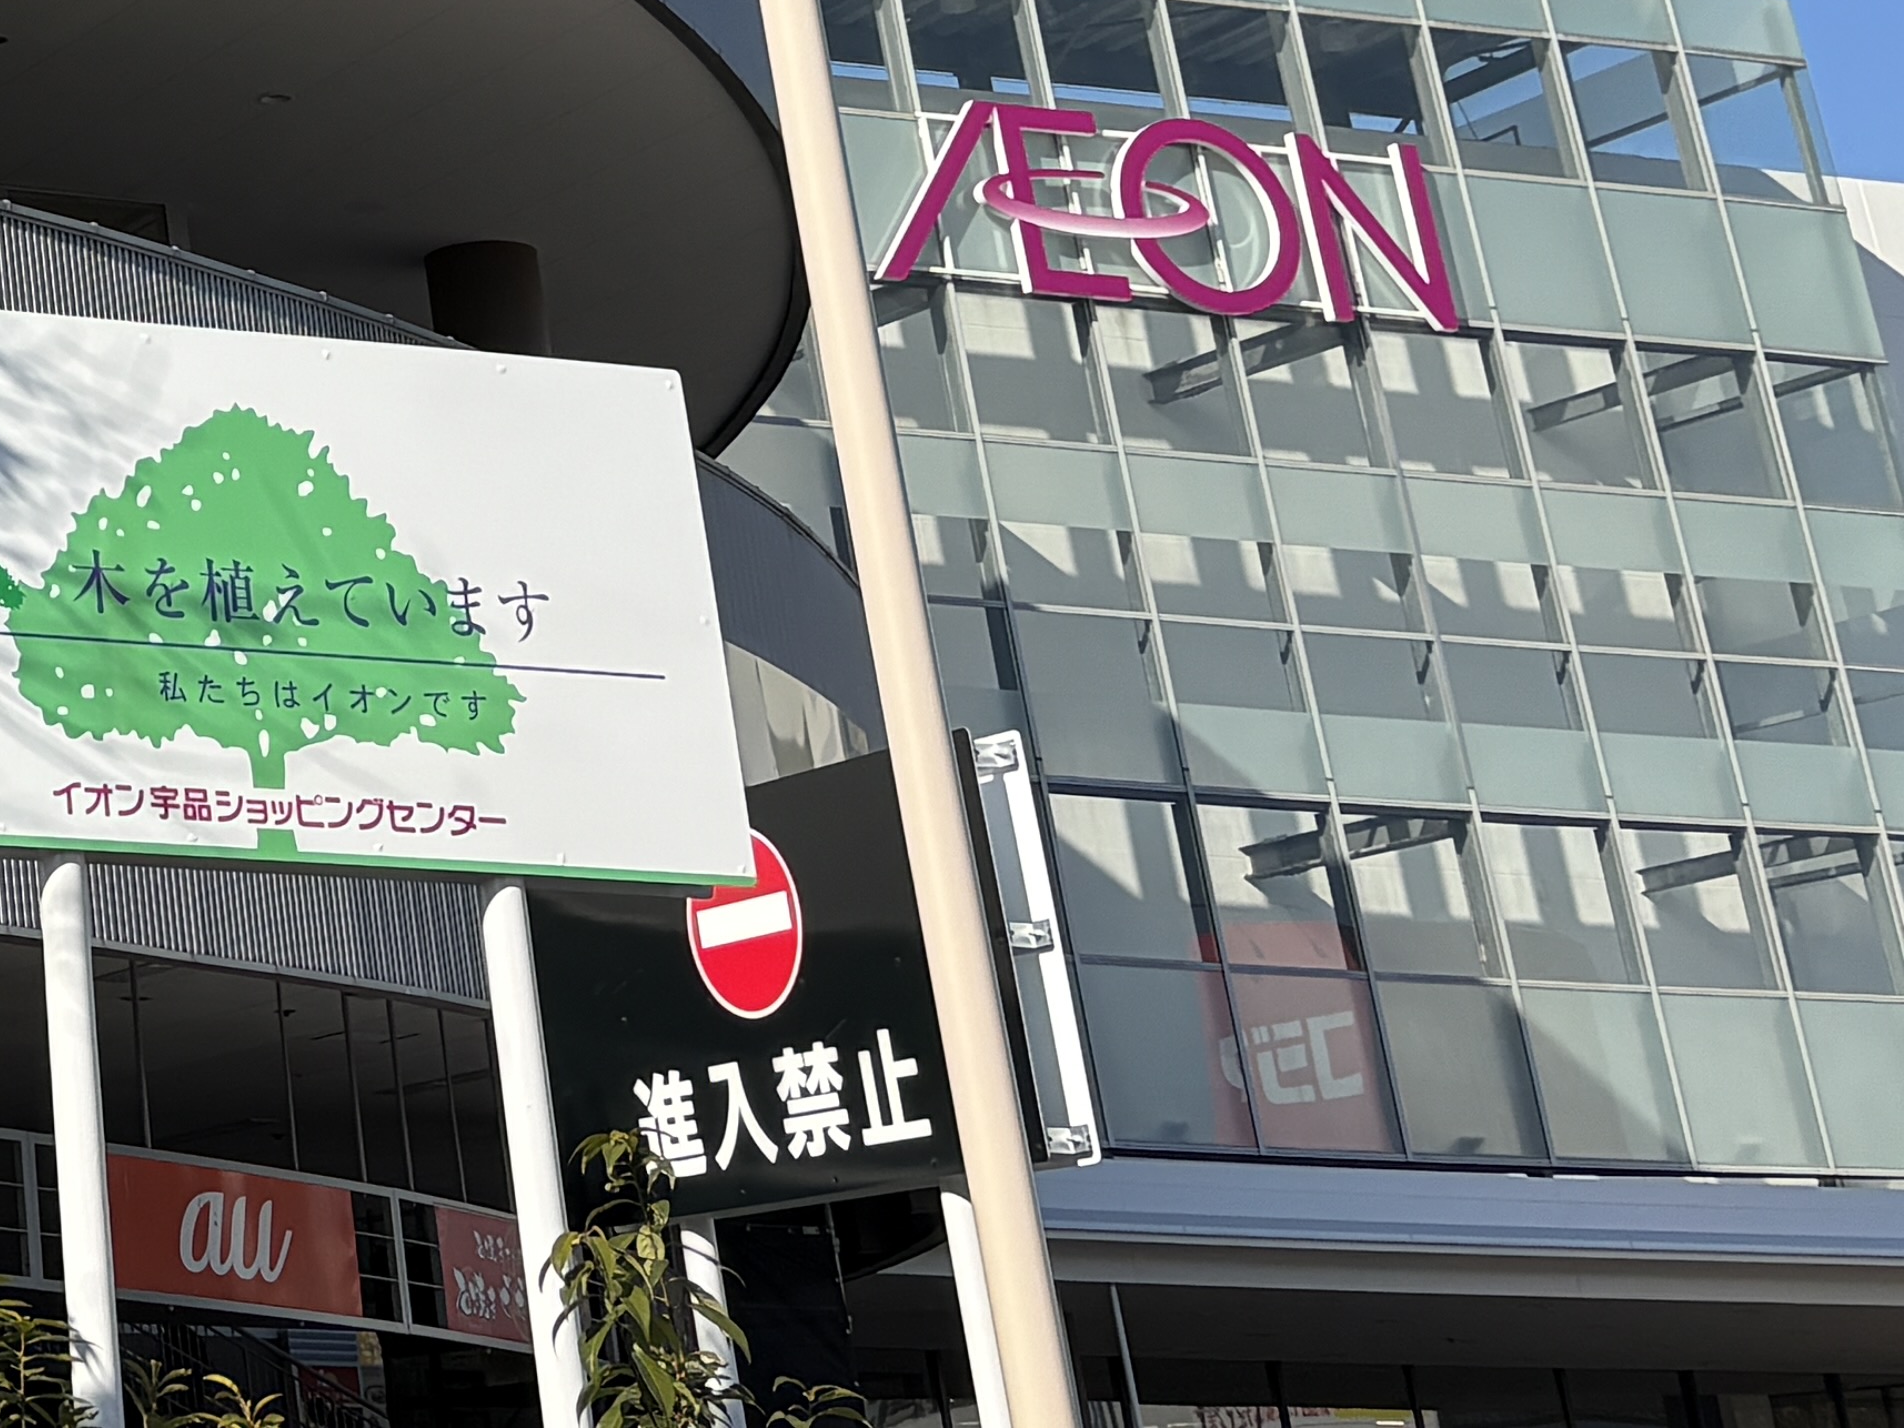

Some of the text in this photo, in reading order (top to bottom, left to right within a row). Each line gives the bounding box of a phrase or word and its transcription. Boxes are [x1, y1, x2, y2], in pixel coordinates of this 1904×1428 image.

[70, 548, 550, 644] 木を植えています
[158, 668, 489, 723] 私たちはイオンです
[52, 781, 507, 838] イオン宇品ショッピングセンター
[633, 1028, 932, 1180] 進入禁止
[179, 1190, 292, 1283] au
